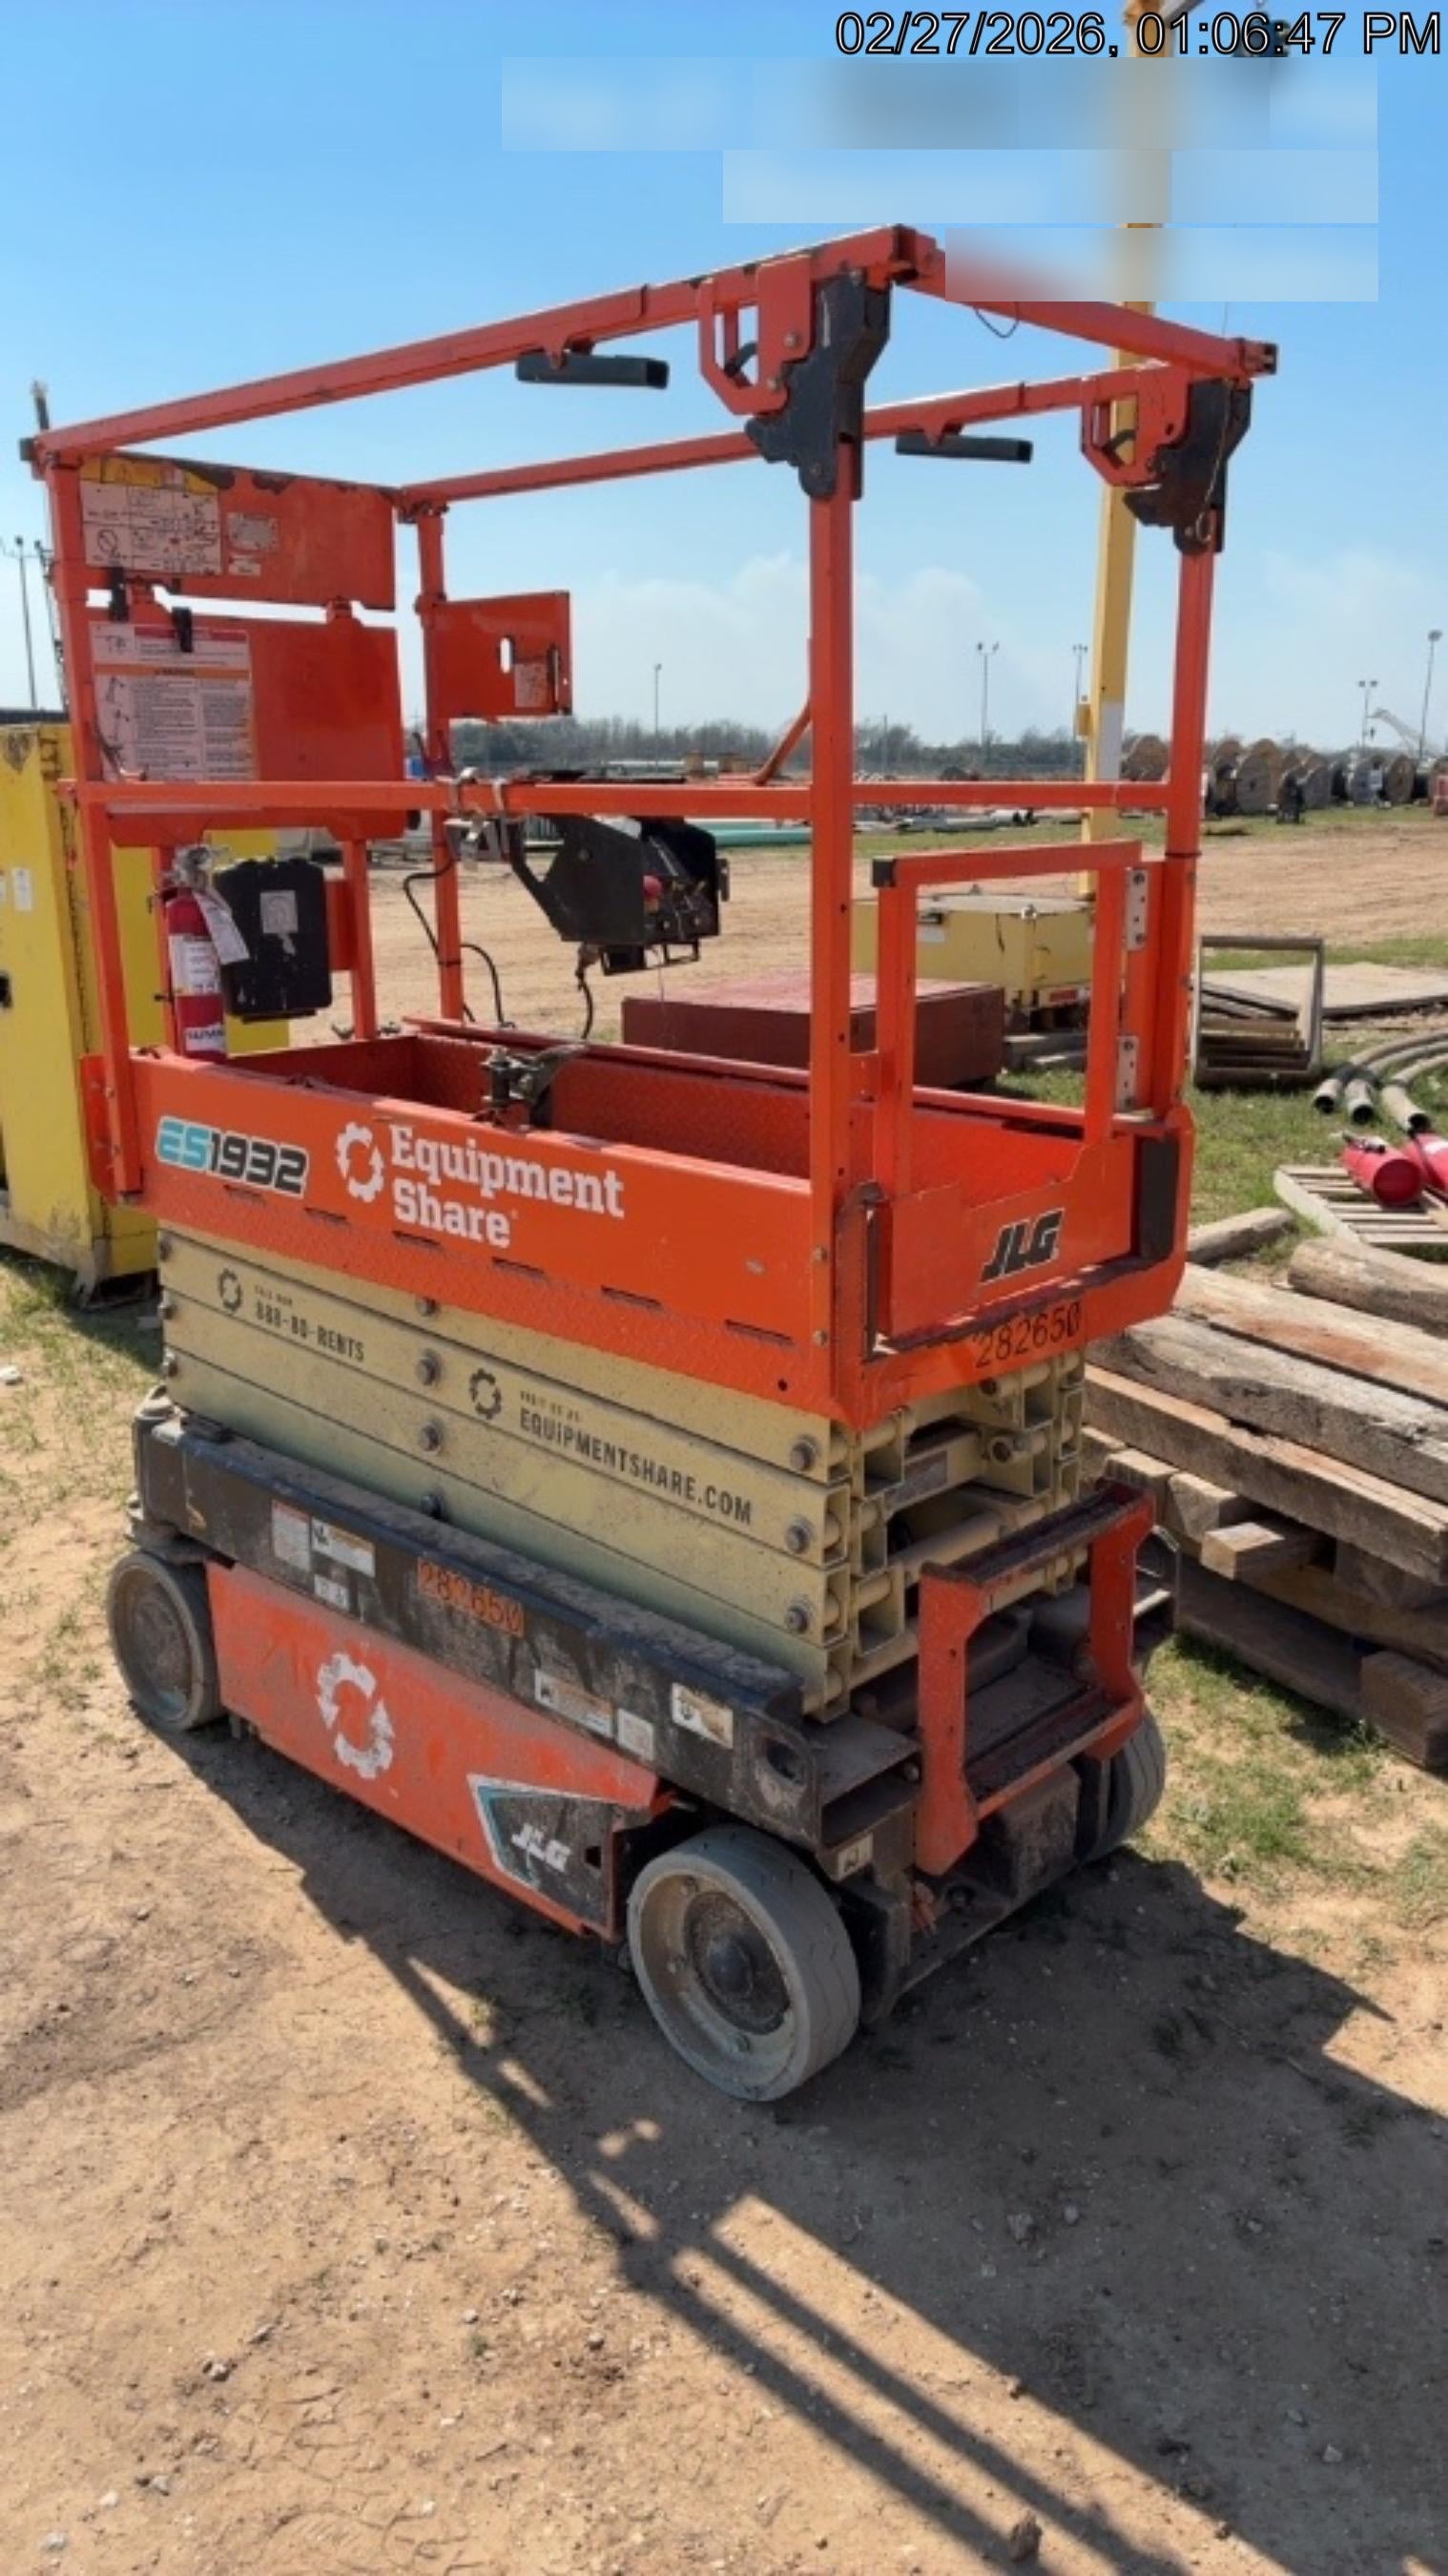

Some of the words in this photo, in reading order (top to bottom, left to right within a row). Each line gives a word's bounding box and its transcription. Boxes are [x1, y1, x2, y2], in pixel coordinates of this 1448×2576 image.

[156, 1117, 307, 1196] ES1932
[390, 1124, 625, 1218] Equipment
[392, 1177, 510, 1249] Share
[979, 1208, 1065, 1285] JLG
[972, 1301, 1082, 1369] 282650
[520, 1407, 752, 1525] EQUIPMENTSHARE.COM
[510, 1822, 571, 1873] JLG
